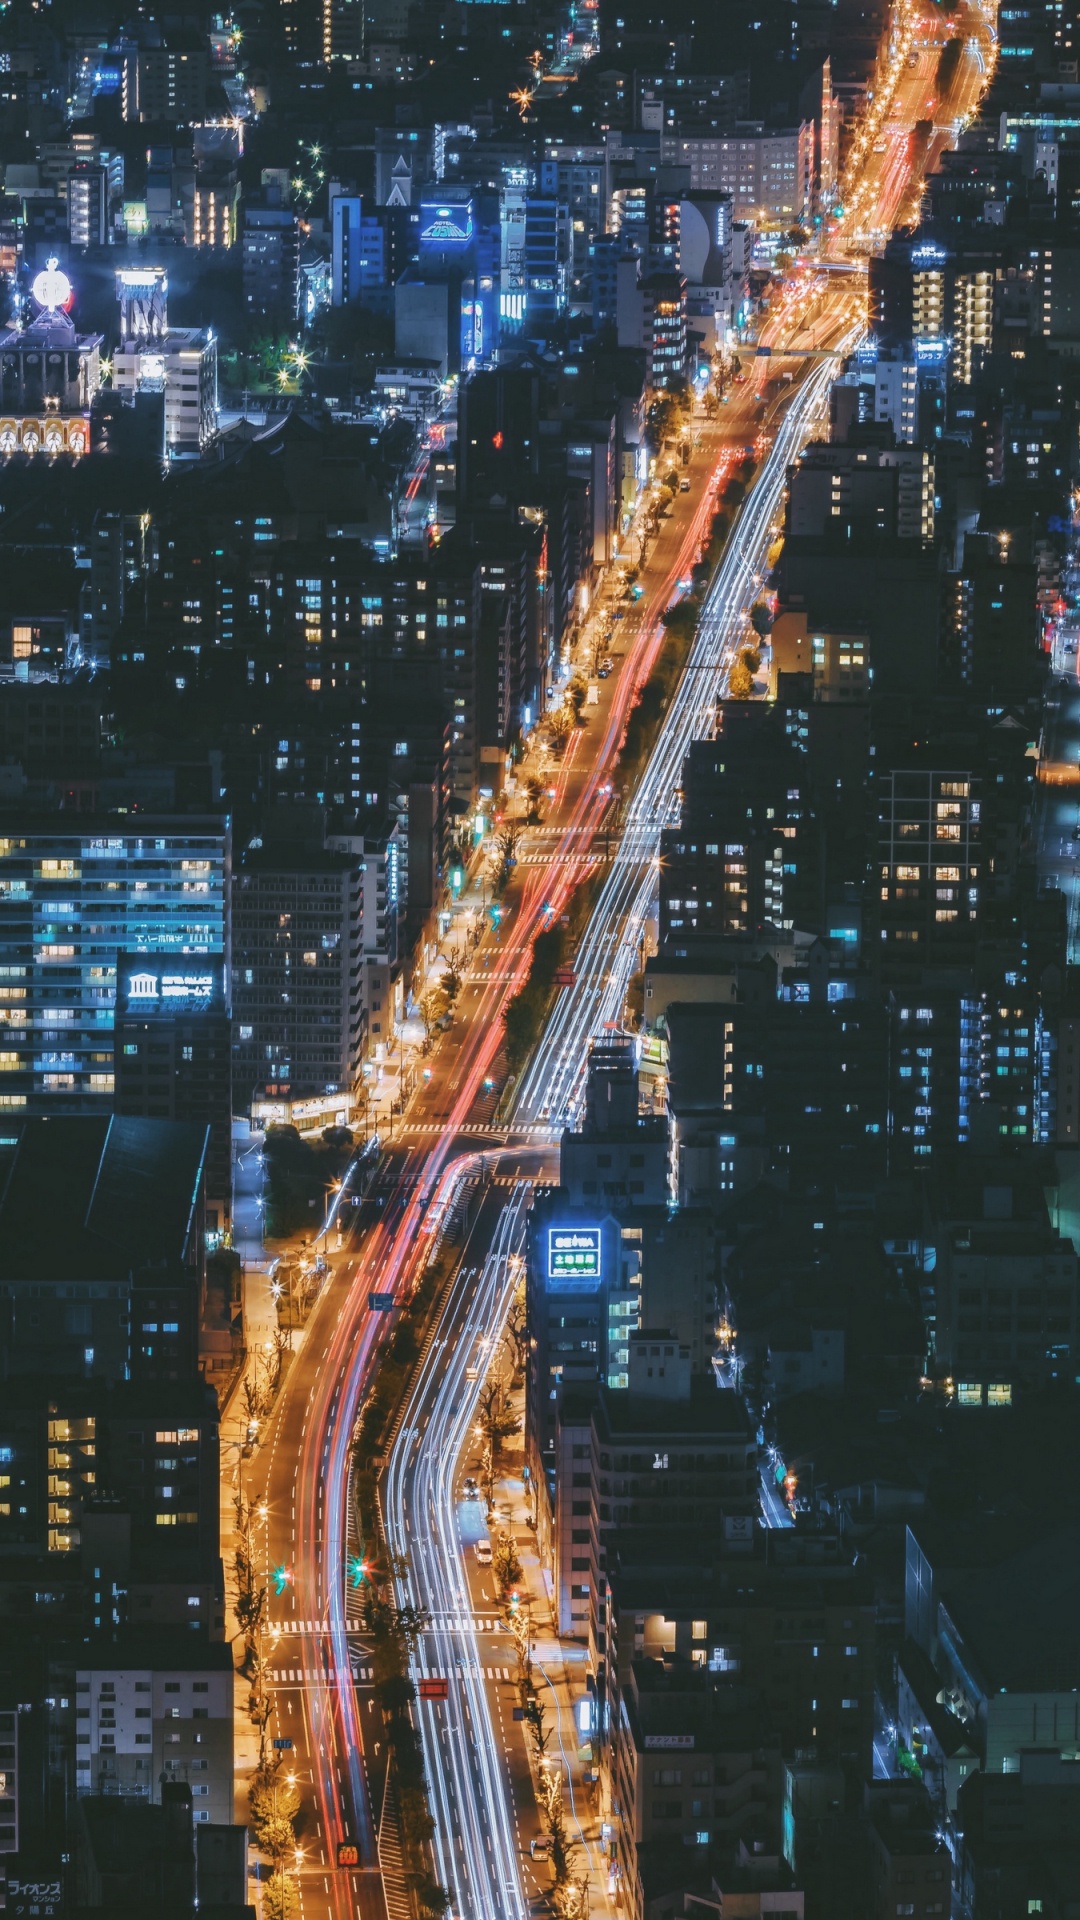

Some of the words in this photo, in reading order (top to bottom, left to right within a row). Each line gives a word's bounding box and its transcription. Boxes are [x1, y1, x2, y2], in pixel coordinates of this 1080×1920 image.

[448, 1081, 459, 1090] 50
[8, 1880, 61, 1896] ライオンズ
[32, 1895, 61, 1903] マンション
[15, 1904, 55, 1916] 夕陽丘
